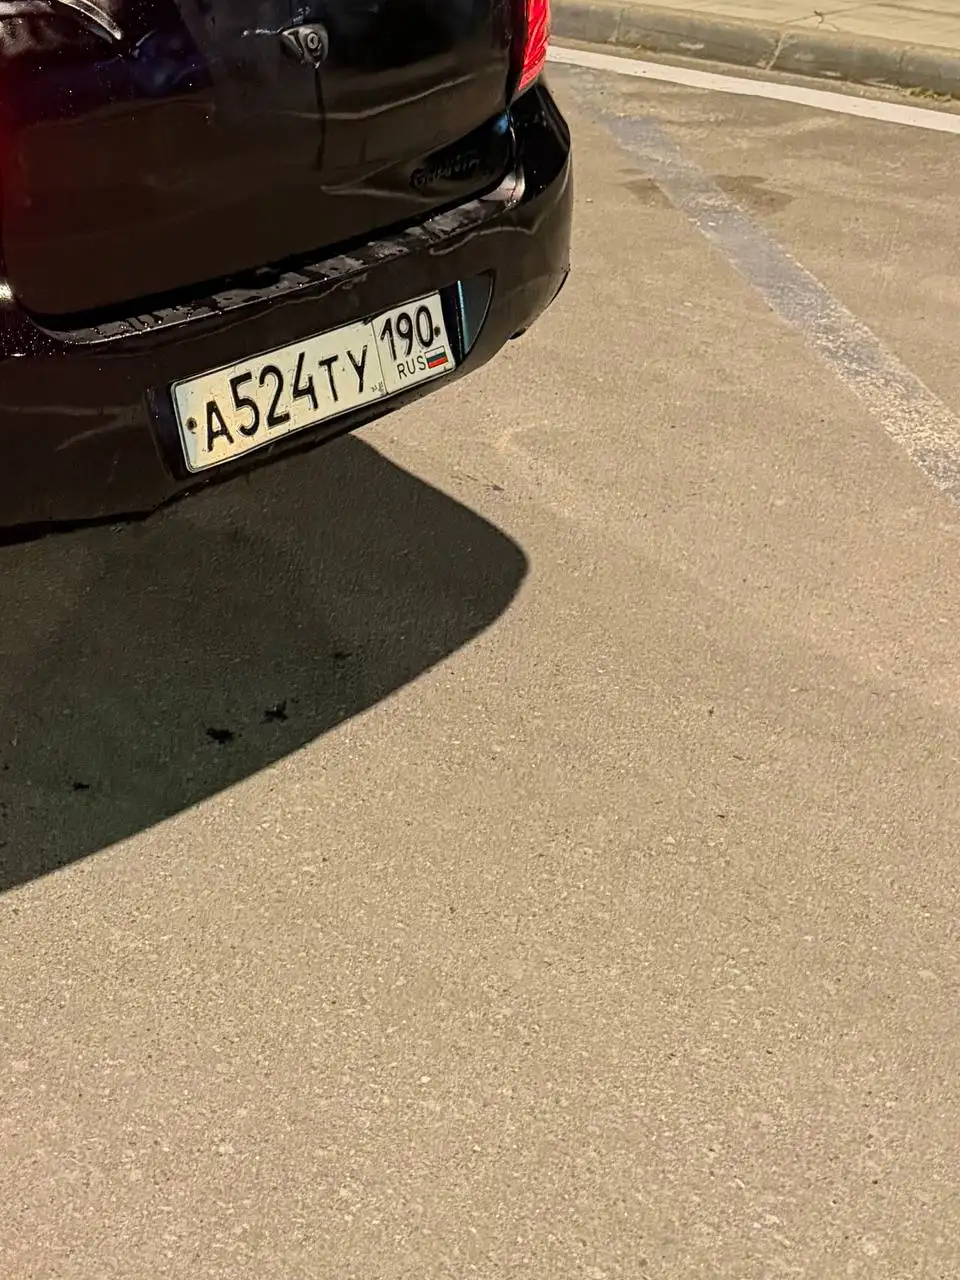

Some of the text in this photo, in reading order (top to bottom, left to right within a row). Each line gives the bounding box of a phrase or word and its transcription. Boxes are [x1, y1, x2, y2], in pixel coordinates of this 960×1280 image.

[205, 305, 434, 452] А524ТУ 190
[396, 355, 427, 379] RUS
